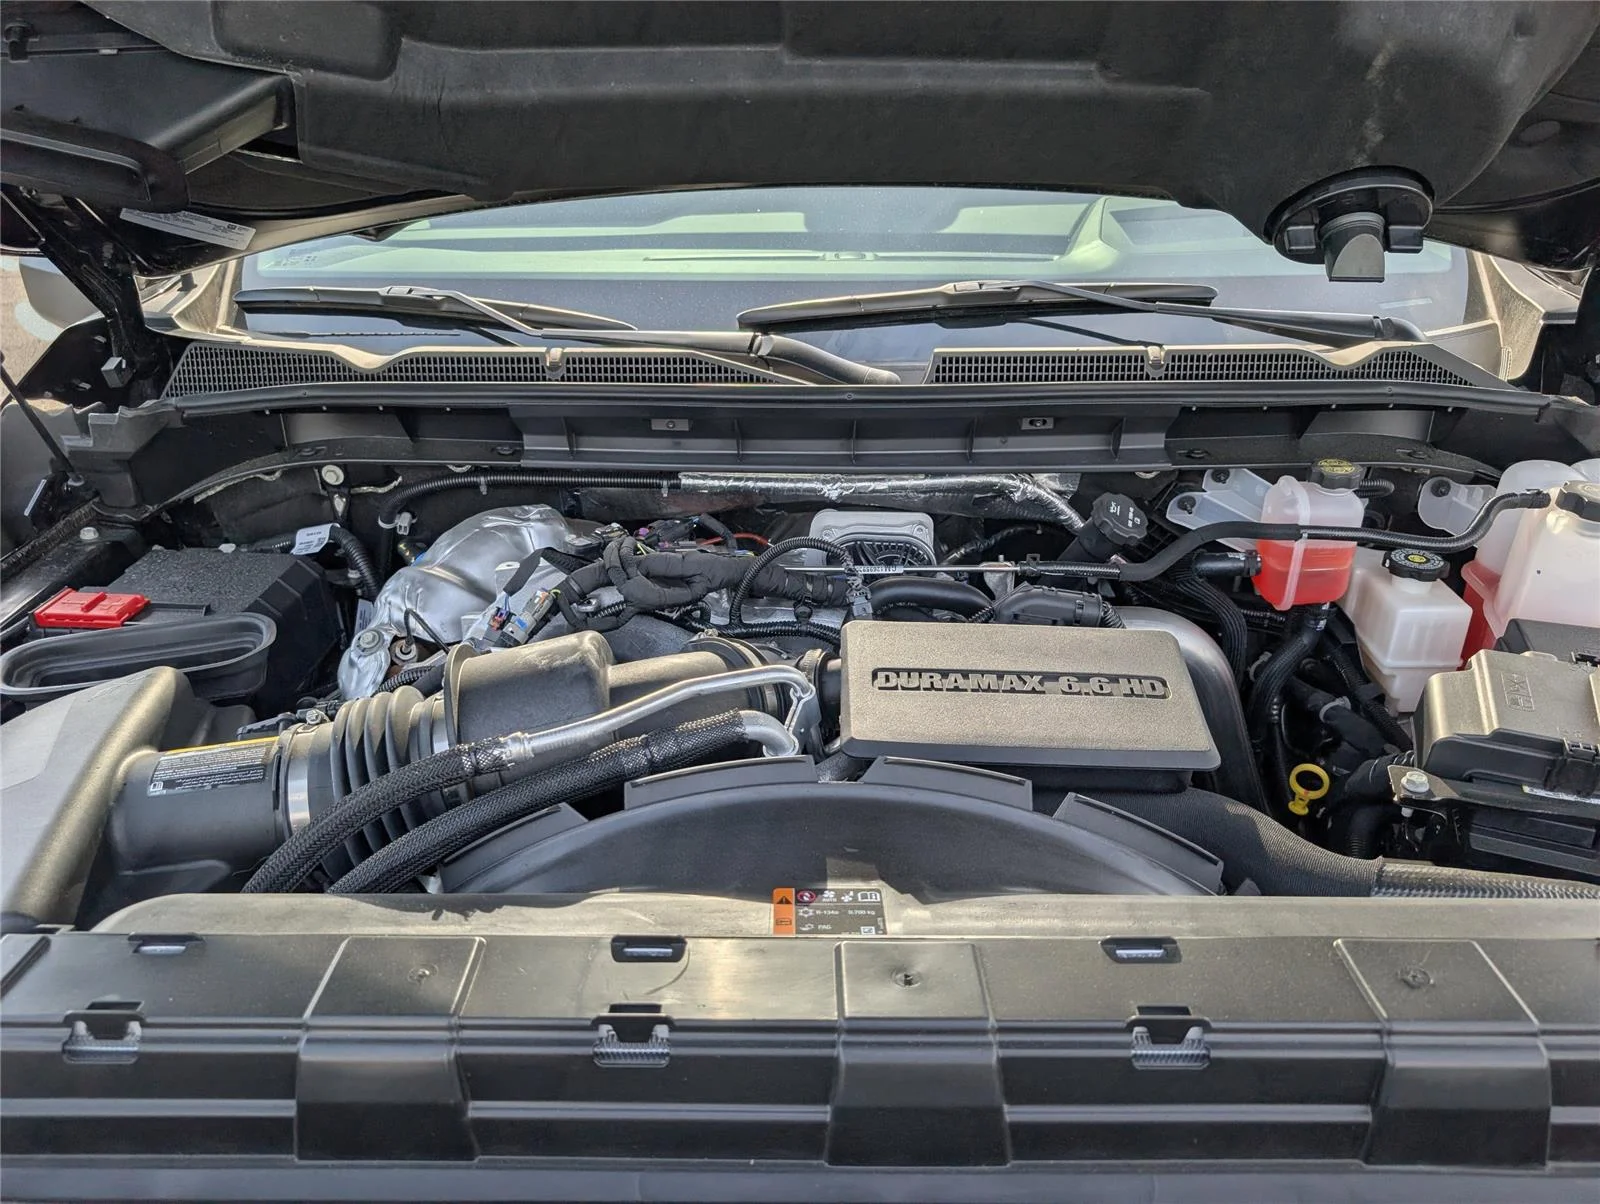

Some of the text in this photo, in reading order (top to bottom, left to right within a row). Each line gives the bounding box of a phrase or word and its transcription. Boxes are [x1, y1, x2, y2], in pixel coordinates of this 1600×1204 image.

[877, 671, 1166, 699] DURAMAX 6.6 HD
